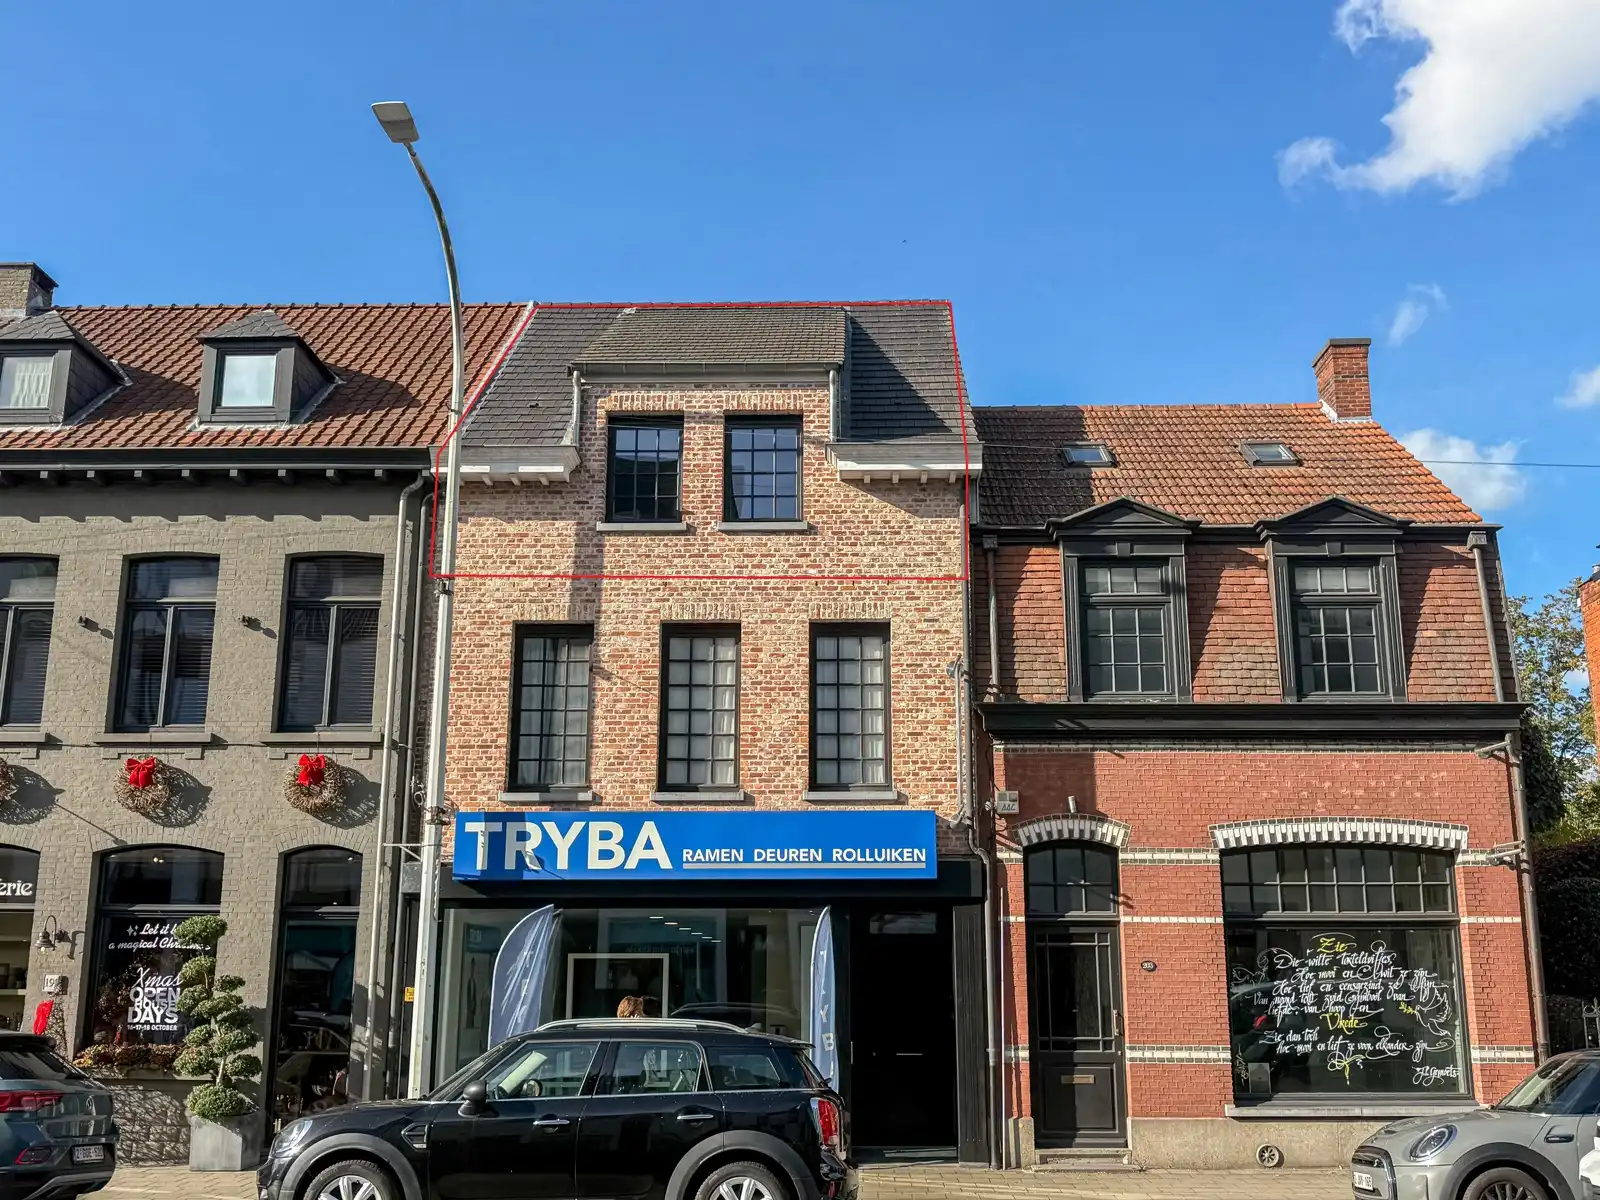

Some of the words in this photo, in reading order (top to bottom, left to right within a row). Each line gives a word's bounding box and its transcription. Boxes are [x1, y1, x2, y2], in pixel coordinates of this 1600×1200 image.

[464, 821, 673, 870] TRYBA
[683, 848, 744, 862] RAMEN
[754, 848, 822, 862] DEUREN
[832, 848, 926, 862] ROLLUIKEN
[139, 924, 158, 935] Let
[160, 924, 171, 935] it
[108, 942, 115, 950] a
[117, 937, 158, 952] magical
[1317, 938, 1357, 953] Zie
[1274, 954, 1304, 969] Die
[1305, 953, 1334, 966] witte
[132, 967, 184, 988] Xmas
[1318, 966, 1338, 978] mooi
[1380, 966, 1402, 978] wit
[129, 987, 180, 1001] OPEN
[1320, 983, 1333, 991] en
[134, 1001, 177, 1009] HOUSE
[1301, 1005, 1321, 1013] van
[128, 1006, 178, 1024] DAYS
[1320, 1013, 1367, 1033] Vrede
[1259, 1030, 1284, 1044] Zie
[1286, 1030, 1301, 1041] dan
[1295, 1043, 1312, 1055] mooi
[1317, 1042, 1326, 1051] en
